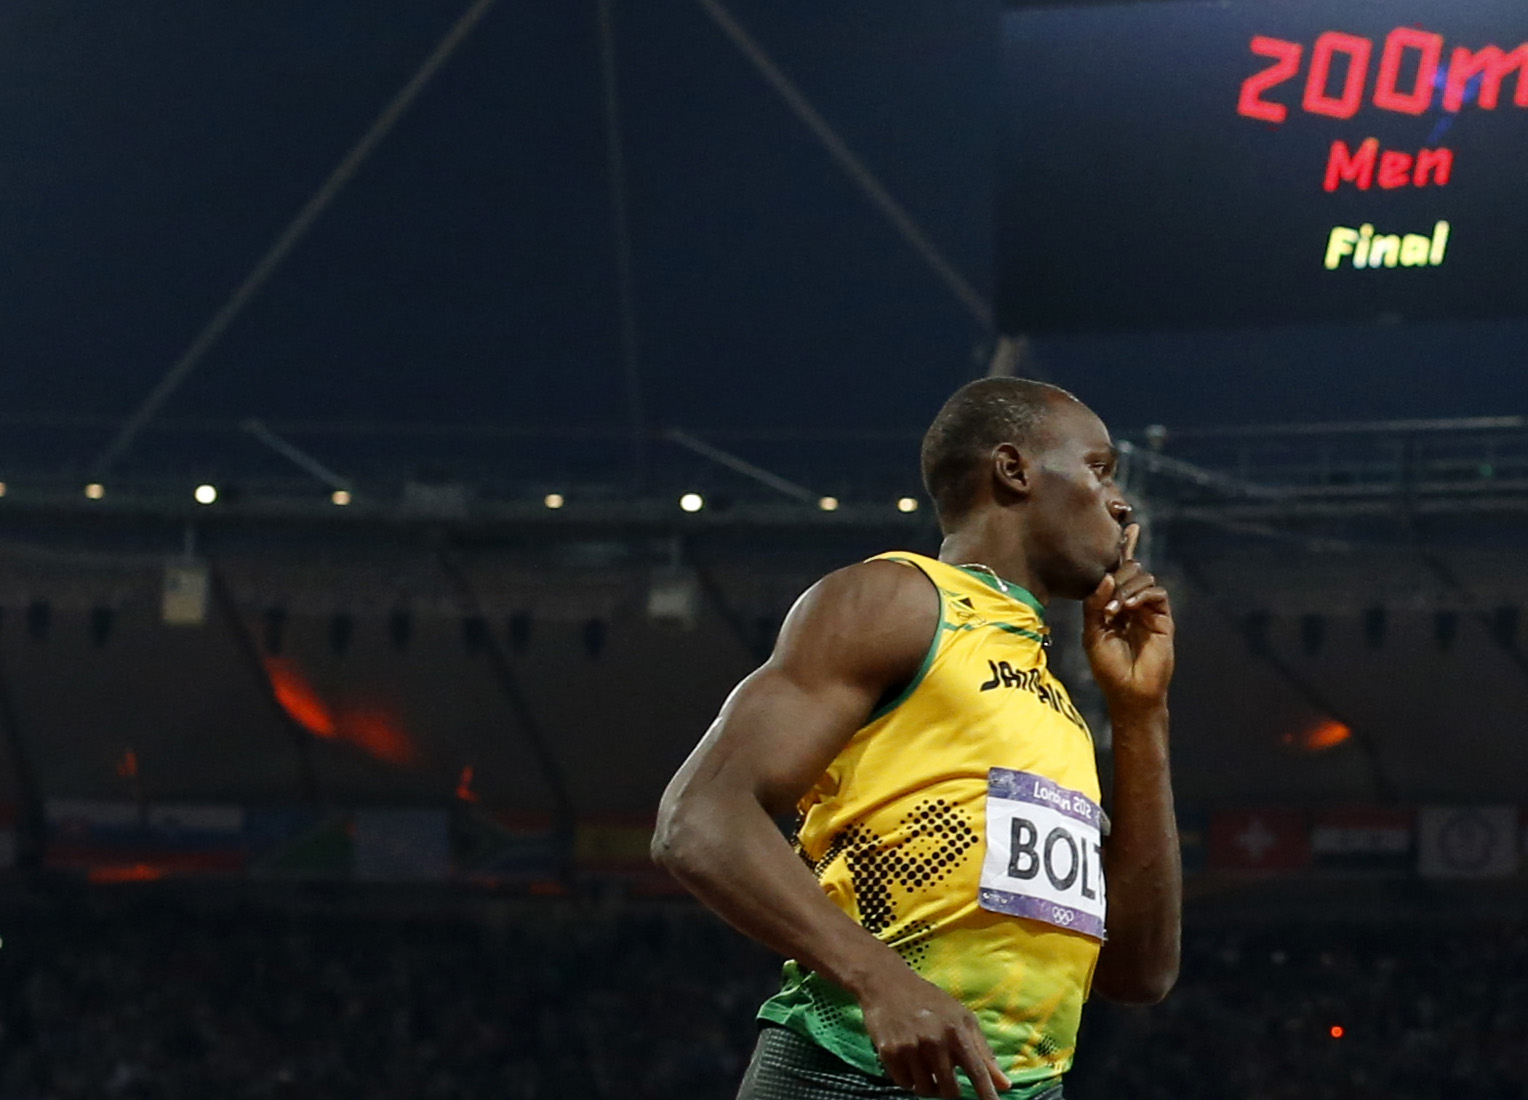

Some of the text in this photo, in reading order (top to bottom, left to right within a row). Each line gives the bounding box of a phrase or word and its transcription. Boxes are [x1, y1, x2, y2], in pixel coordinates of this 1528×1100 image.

[1323, 137, 1453, 192] Men
[1325, 220, 1450, 270] Final
[980, 659, 1091, 742] JAMAIC
[1033, 781, 1071, 810] Lonn
